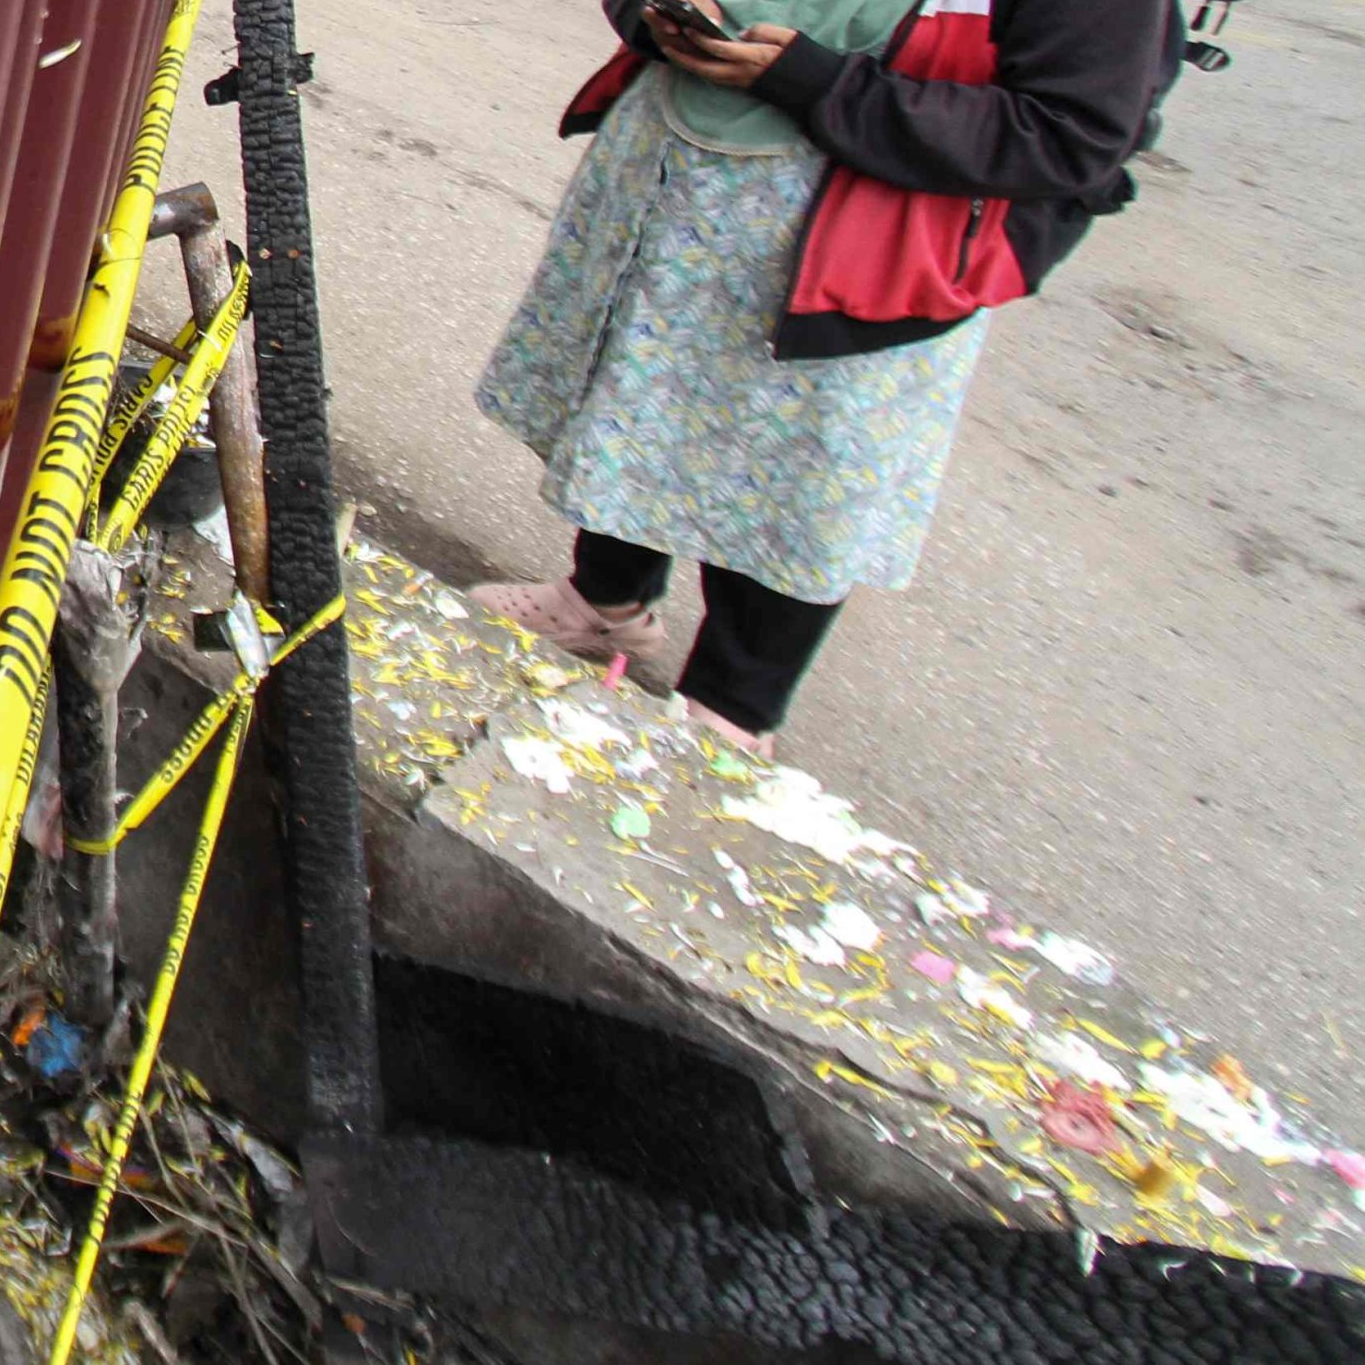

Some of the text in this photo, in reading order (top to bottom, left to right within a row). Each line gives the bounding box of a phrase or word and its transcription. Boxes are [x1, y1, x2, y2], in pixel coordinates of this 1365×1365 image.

[38, 346, 118, 510] CROSS
[122, 443, 164, 510] GARIS
[10, 490, 78, 605] NOT
